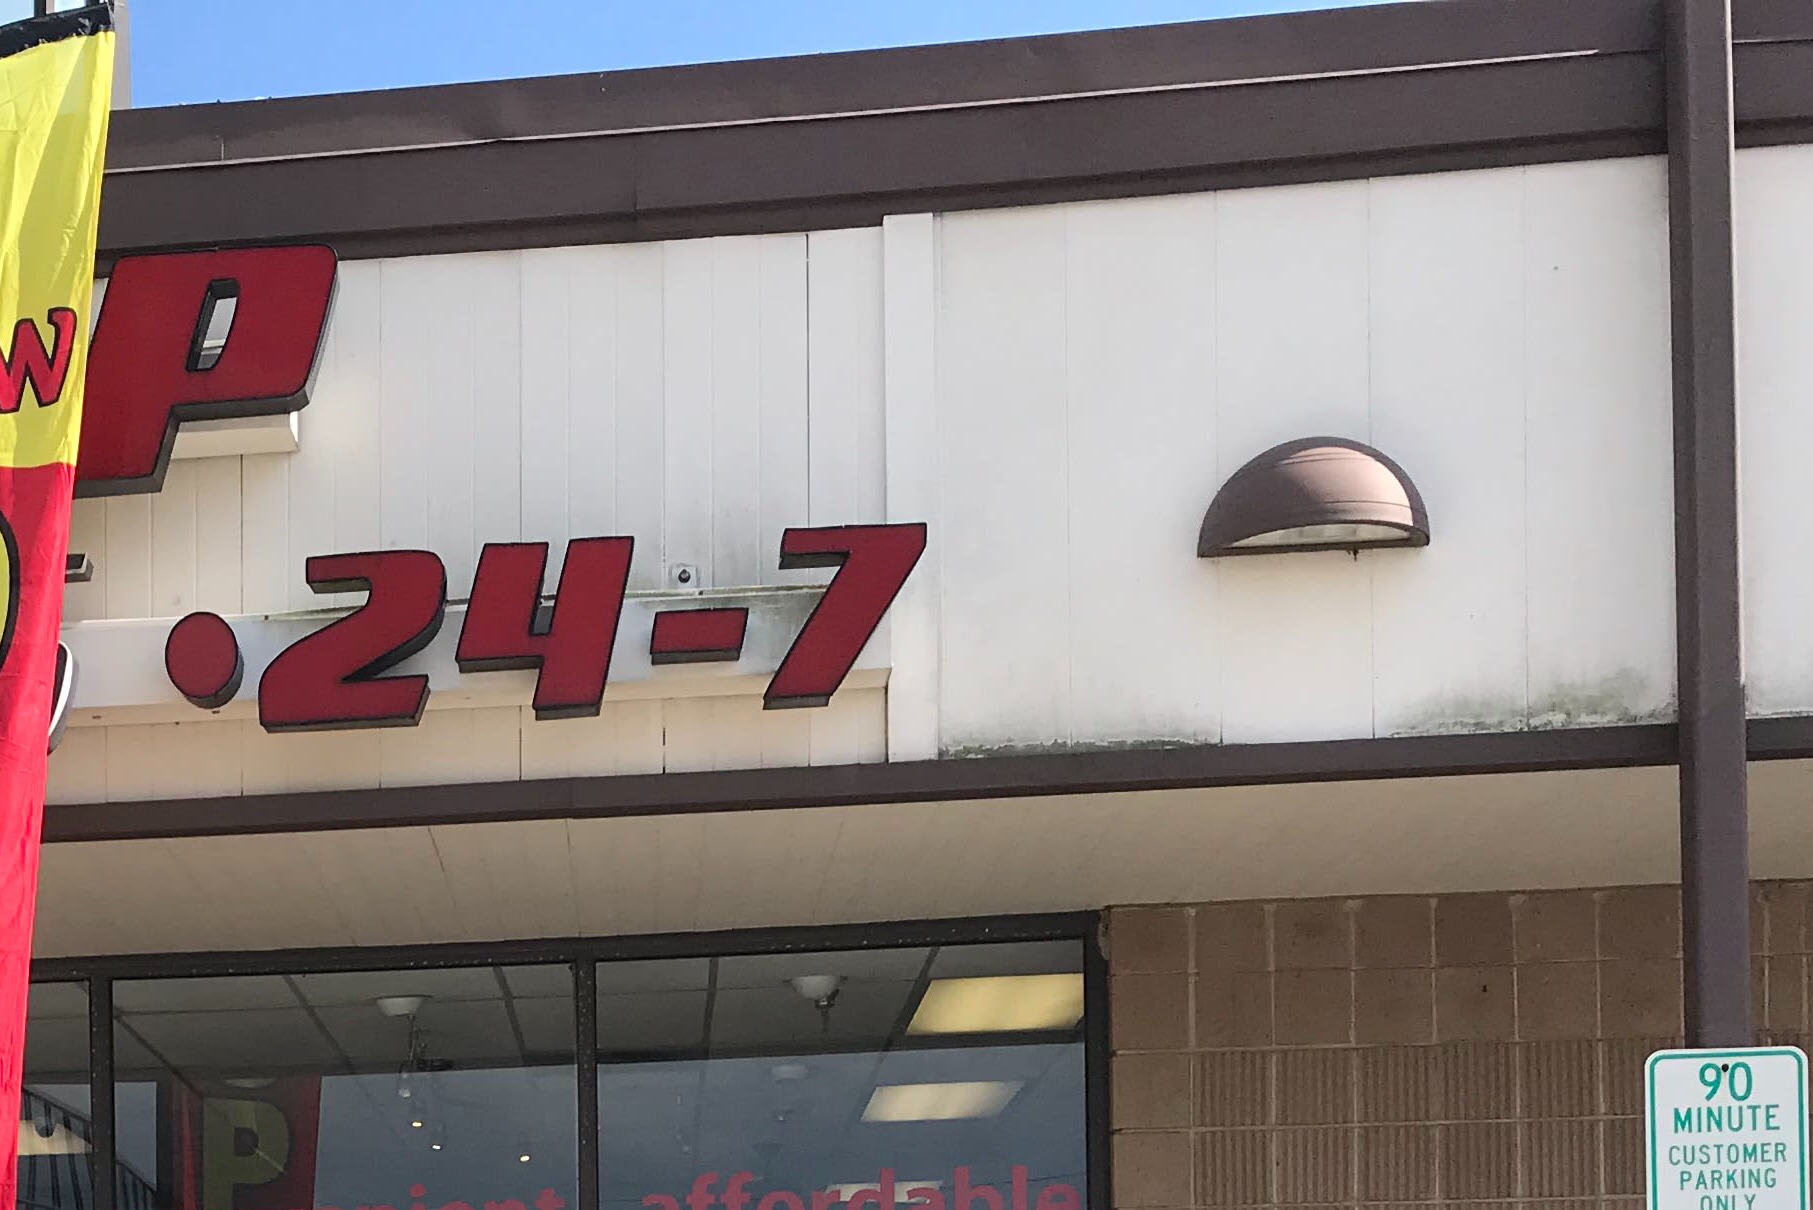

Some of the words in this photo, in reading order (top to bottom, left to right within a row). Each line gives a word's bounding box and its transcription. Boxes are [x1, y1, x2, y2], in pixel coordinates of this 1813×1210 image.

[259, 523, 927, 733] 24-7
[1699, 1062, 1752, 1101] 90
[1674, 1104, 1780, 1133] MINUTE
[1669, 1143, 1787, 1165] CUSTOMER
[1680, 1168, 1776, 1190] PARKING
